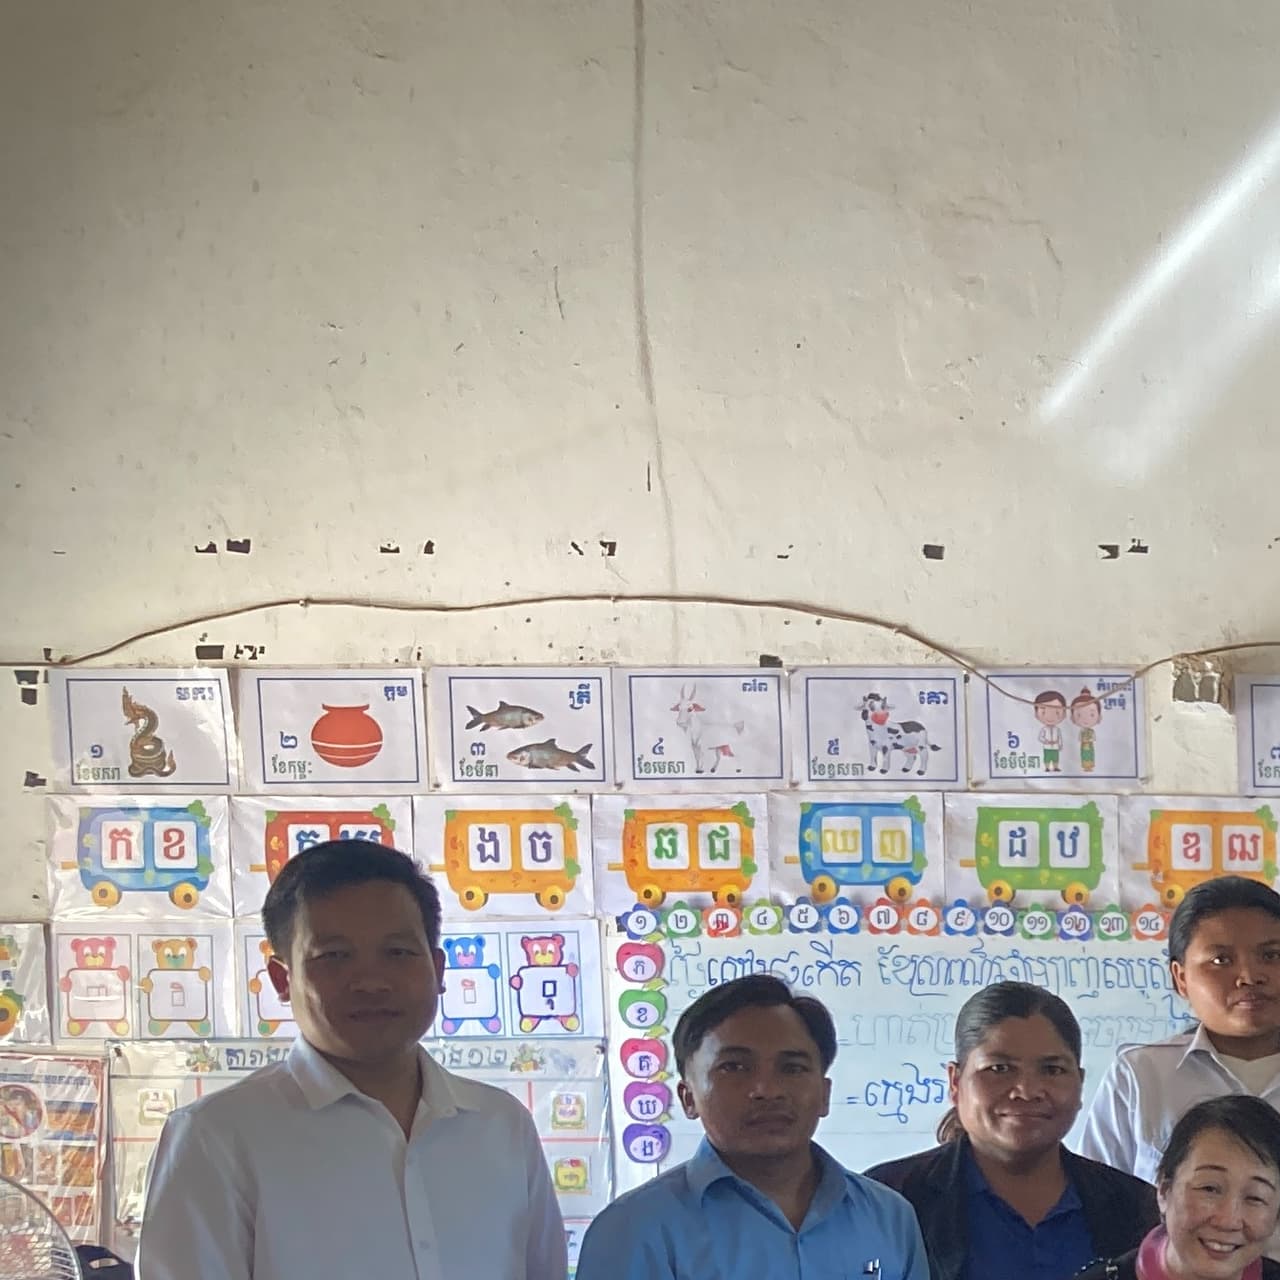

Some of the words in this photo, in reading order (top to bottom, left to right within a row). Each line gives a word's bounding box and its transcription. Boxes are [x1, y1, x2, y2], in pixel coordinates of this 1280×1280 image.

[280, 731, 297, 749] ២
[471, 742, 485, 756] ៣
[652, 737, 664, 755] ៤
[827, 738, 839, 755] ៥
[1008, 731, 1019, 748] ៦
[459, 757, 498, 777] ខែមីនា
[637, 757, 685, 776] ខែមេសា
[109, 828, 133, 860] ក
[163, 828, 185, 860] ខ
[477, 827, 500, 863] ង
[528, 831, 552, 862] ច
[653, 828, 678, 859] ឆ
[707, 825, 729, 861] ជ
[823, 829, 859, 852] ឈ
[1009, 827, 1026, 857] ដ
[1057, 827, 1081, 858] ឋ
[1183, 832, 1200, 862] ឌ
[1228, 833, 1261, 861] ឍ
